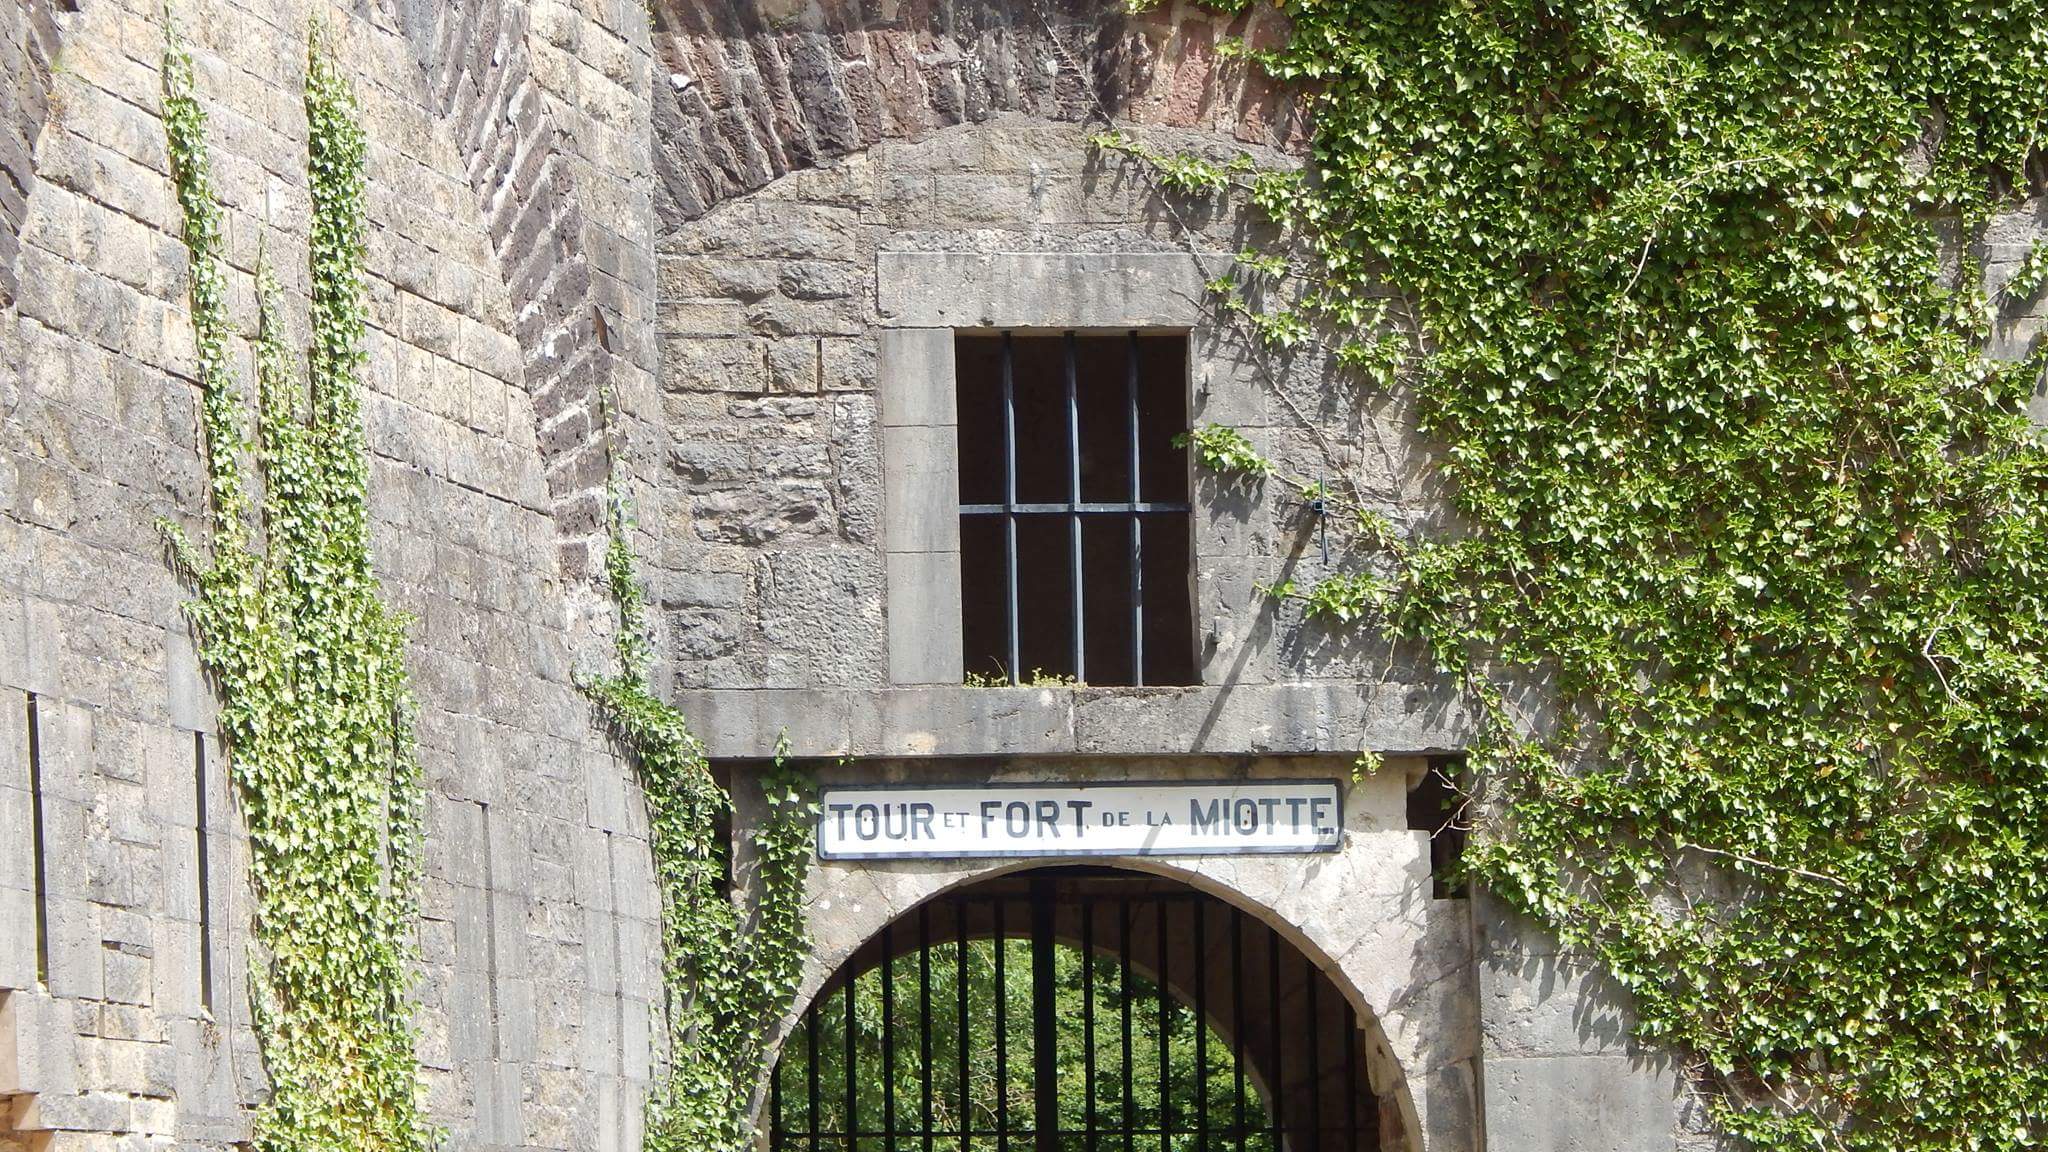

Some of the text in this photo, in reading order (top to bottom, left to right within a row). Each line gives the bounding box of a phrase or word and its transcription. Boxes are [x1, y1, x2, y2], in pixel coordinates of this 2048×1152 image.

[828, 802, 936, 841] TOUR
[943, 811, 970, 828] ET
[980, 800, 1093, 839] FORT
[1102, 811, 1131, 828] DE
[1146, 810, 1173, 827] LA
